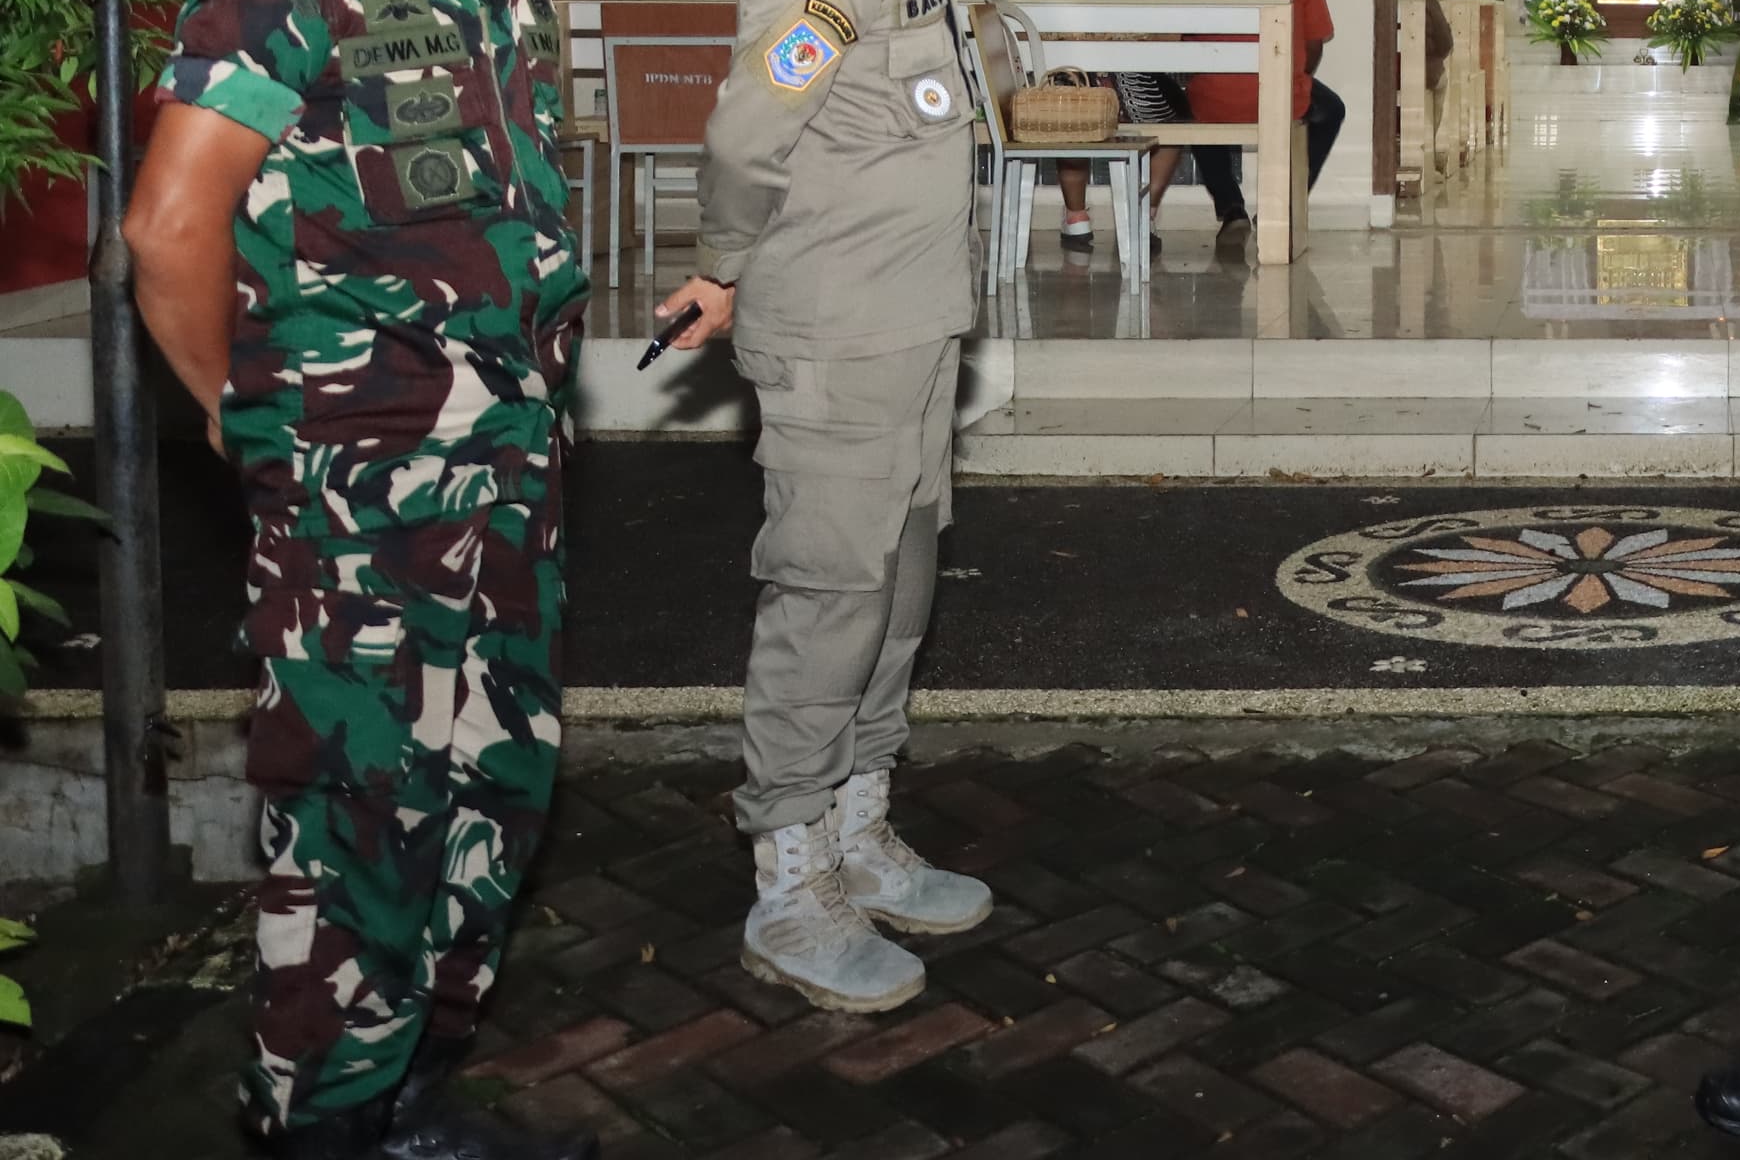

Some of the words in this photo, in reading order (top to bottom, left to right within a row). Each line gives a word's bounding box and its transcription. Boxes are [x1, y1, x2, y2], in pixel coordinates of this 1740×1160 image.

[353, 40, 421, 68] DEWA
[644, 72, 681, 84] IPDN
[683, 74, 713, 86] NTB
